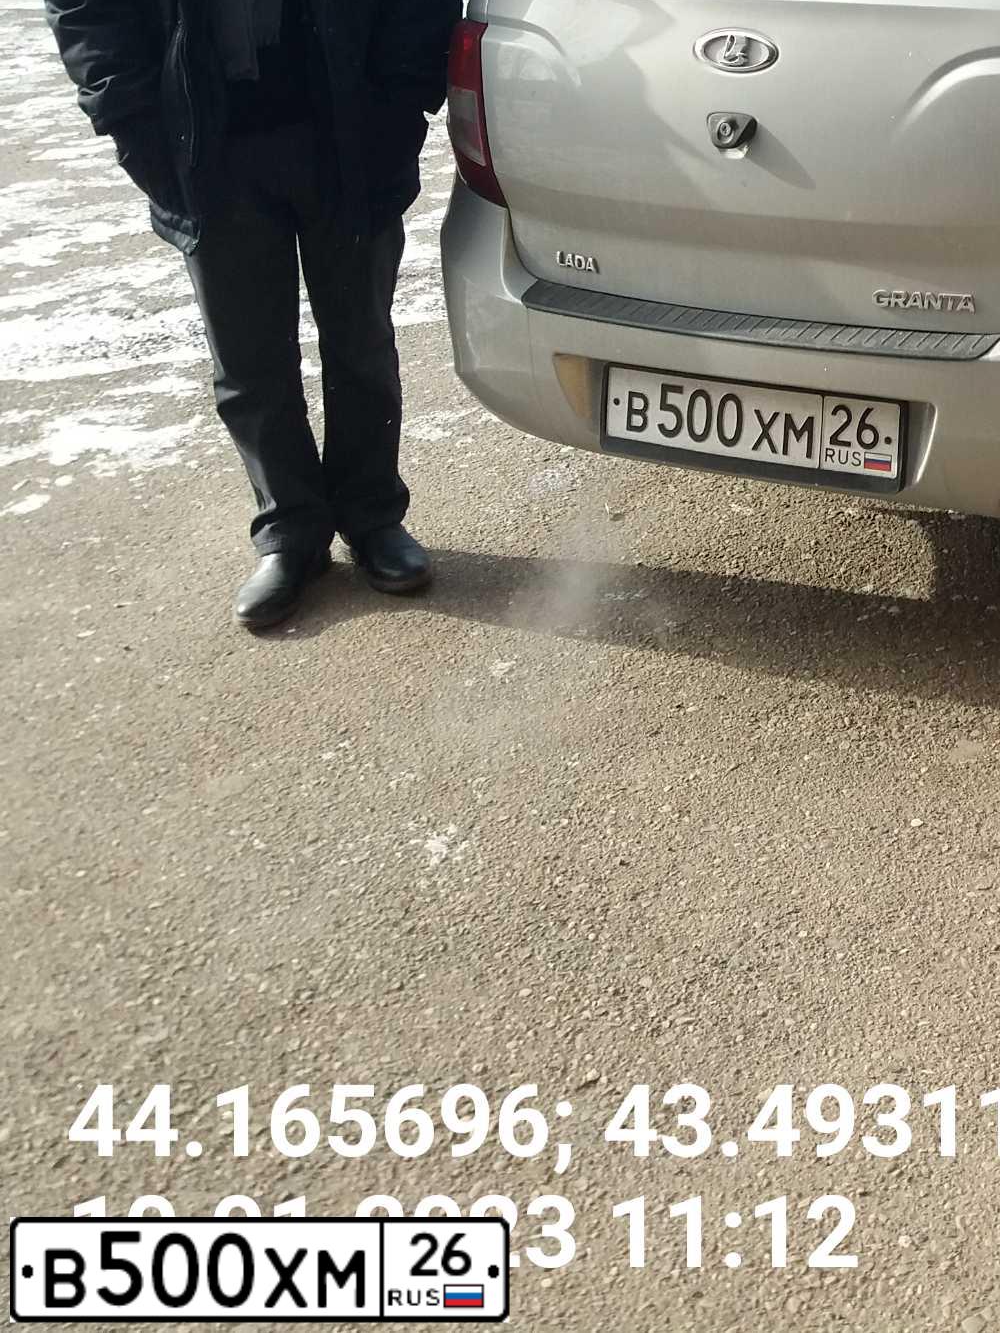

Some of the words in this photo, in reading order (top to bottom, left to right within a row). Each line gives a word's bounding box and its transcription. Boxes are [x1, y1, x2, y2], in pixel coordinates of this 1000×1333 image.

[556, 250, 599, 273] LADA
[872, 289, 976, 314] GRANTA
[828, 404, 879, 449] 26
[824, 447, 862, 467] RUS
